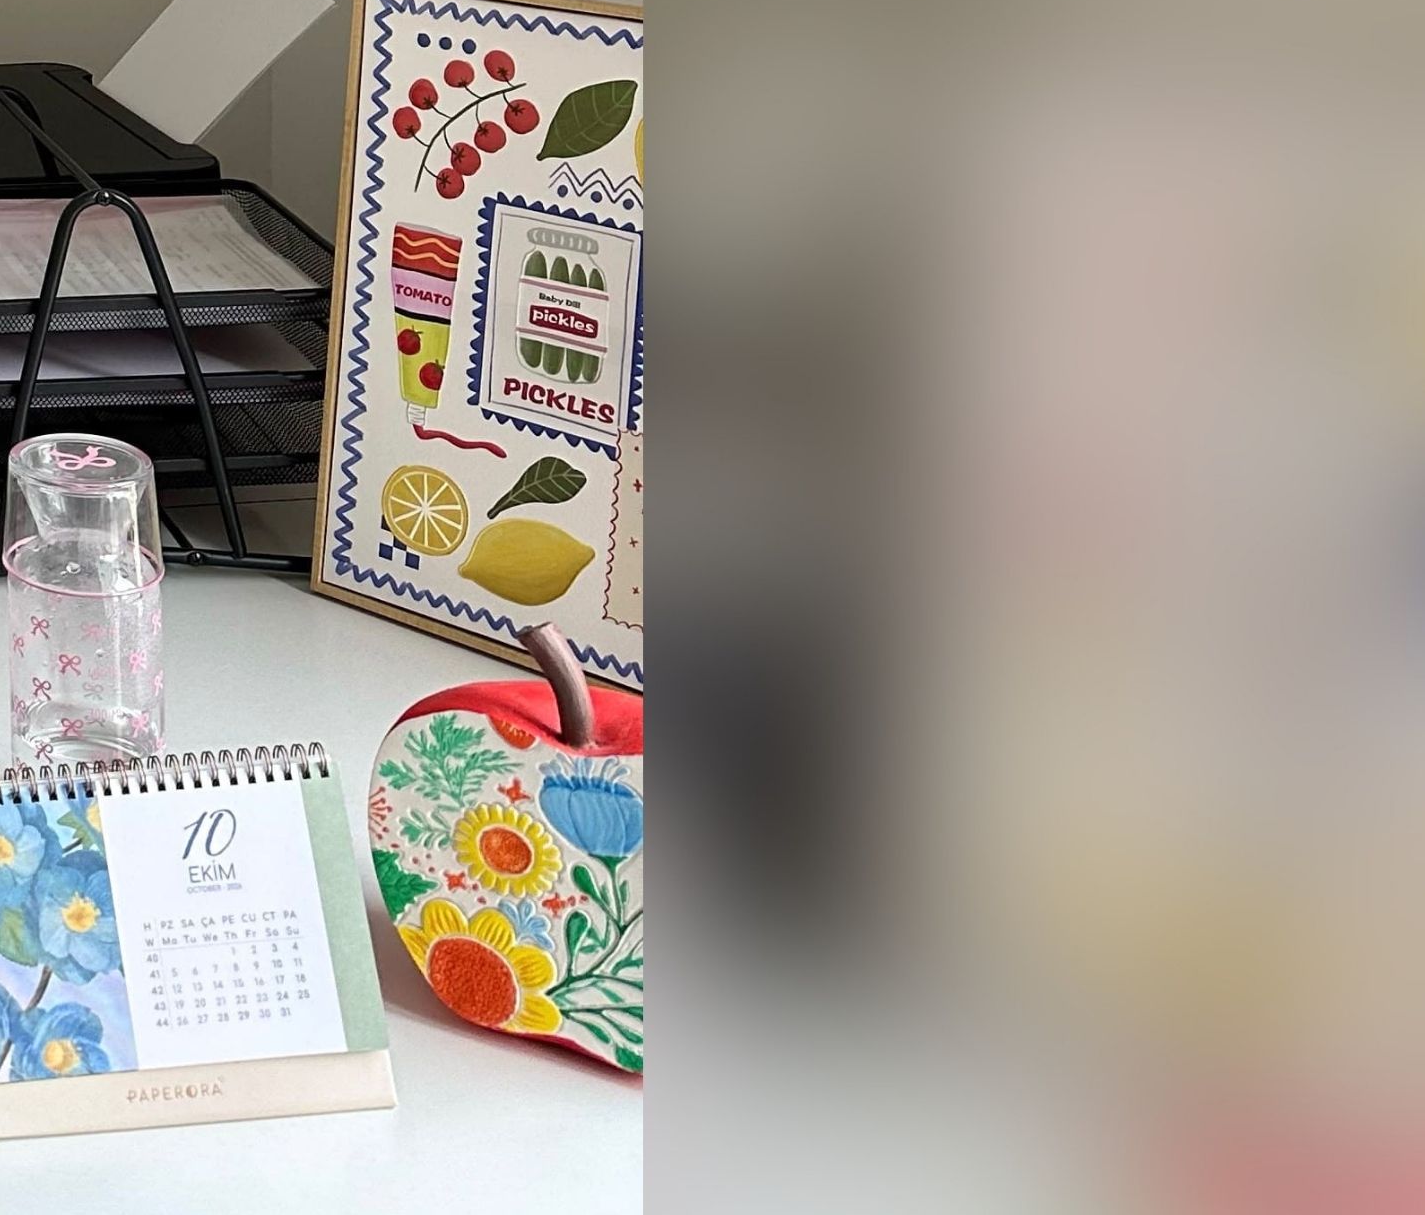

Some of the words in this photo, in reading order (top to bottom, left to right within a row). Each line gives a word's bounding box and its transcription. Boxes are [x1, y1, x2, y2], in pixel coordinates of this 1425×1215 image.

[395, 284, 452, 307] TOMATO
[539, 293, 564, 306] Baby
[565, 300, 581, 309] Dill
[532, 309, 595, 334] pickles
[503, 377, 615, 424] PICKLES
[182, 809, 236, 860] 10
[188, 860, 236, 883] EKİM
[187, 884, 221, 894] OCTOBER
[160, 921, 174, 929] PZ
[180, 919, 195, 928] SA
[201, 917, 215, 928] ÇA
[222, 915, 235, 924] PE
[241, 913, 256, 922] CU
[262, 911, 275, 921] CT
[283, 910, 297, 919] PA
[152, 986, 164, 995] 42
[172, 984, 182, 994] 12
[193, 982, 203, 991] 13
[213, 980, 224, 989] 14
[233, 979, 244, 988] 15
[254, 977, 265, 986] 16
[275, 975, 284, 984] 17
[295, 974, 306, 983] 18
[154, 1002, 166, 1011] 43
[175, 1000, 184, 1009] 19
[195, 998, 206, 1008] 20
[216, 997, 226, 1006] 21
[236, 995, 248, 1004] 22
[256, 993, 269, 1002] 23
[276, 991, 289, 1001] 24
[297, 989, 310, 999] 25
[156, 1018, 169, 1027] 44
[176, 1017, 189, 1026] 26
[198, 1014, 208, 1024] 27
[217, 1013, 229, 1022] 28
[238, 1011, 250, 1020] 29
[259, 1009, 271, 1018] 30
[280, 1007, 291, 1016] 31
[127, 1084, 223, 1102] PAPERORA
